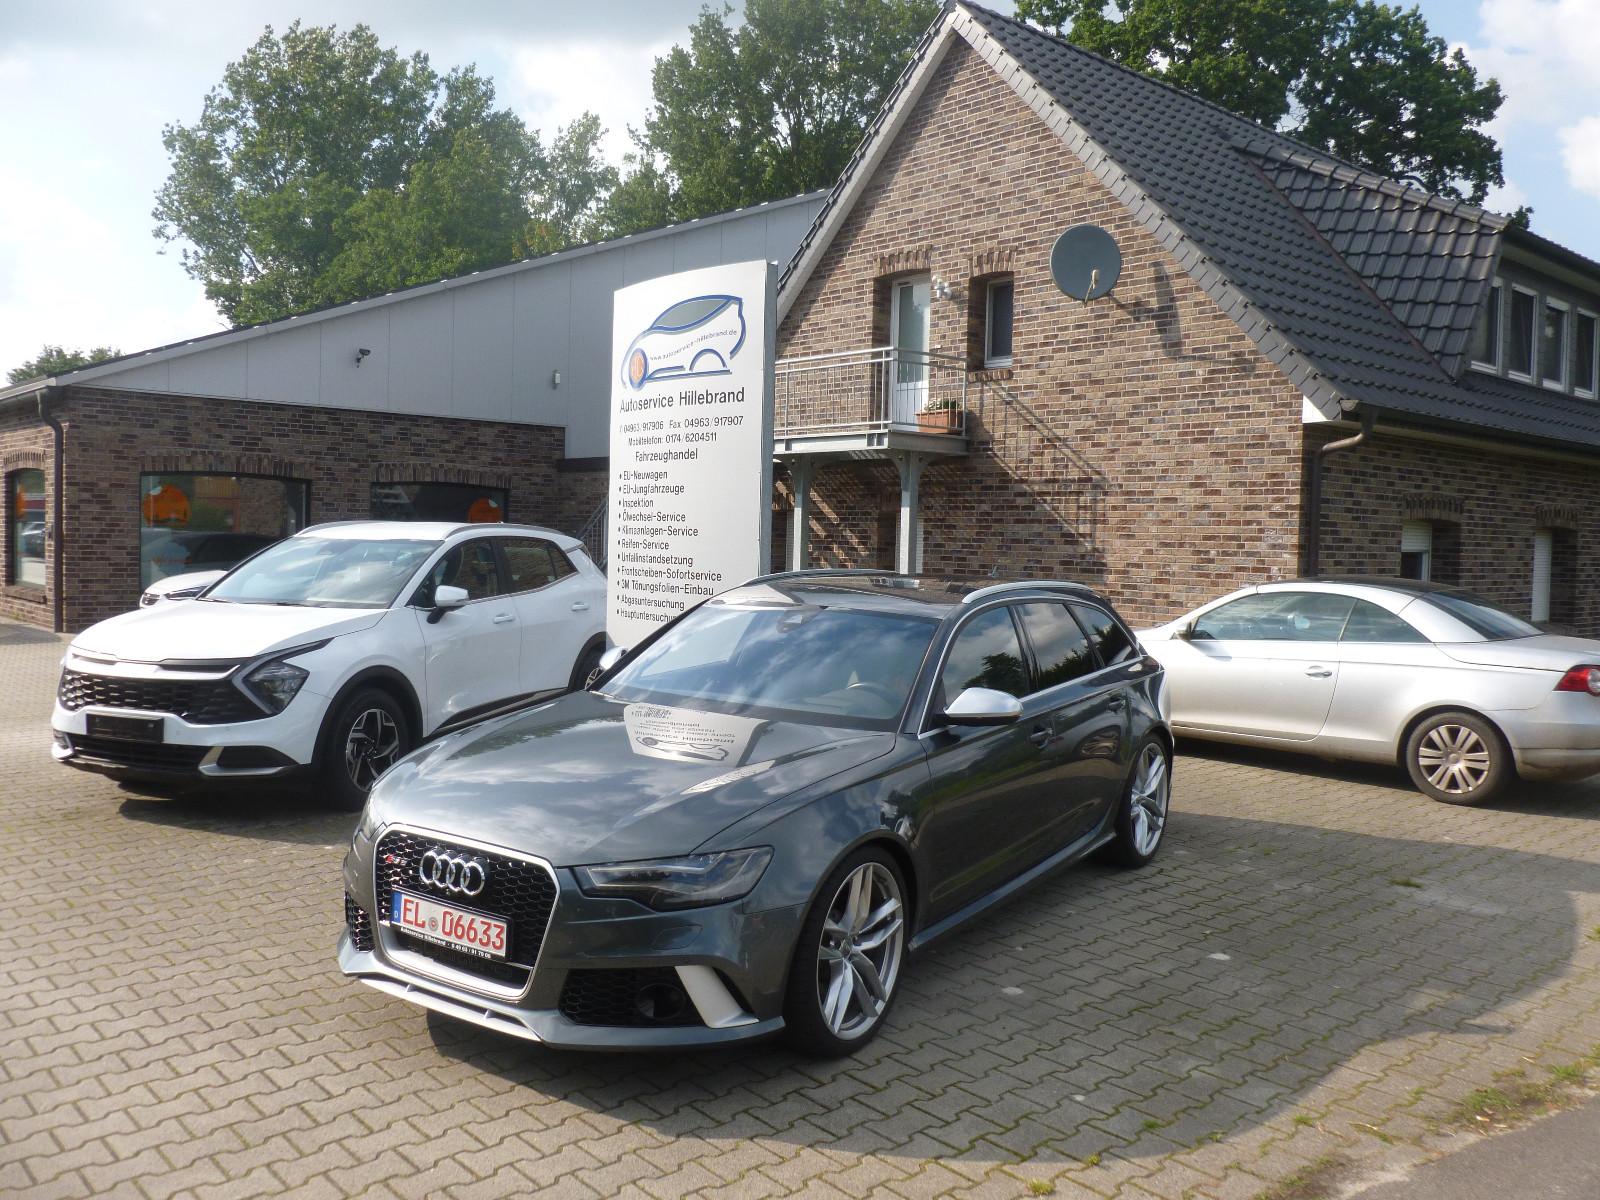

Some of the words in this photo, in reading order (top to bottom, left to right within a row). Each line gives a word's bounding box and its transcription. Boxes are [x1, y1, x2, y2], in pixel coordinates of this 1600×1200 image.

[619, 394, 674, 413] Autoservice
[679, 387, 745, 406] Hillebrand
[669, 420, 681, 429] Fax
[635, 448, 698, 463] Fahrzeughandel
[623, 470, 668, 481] EU-Neuwagen
[623, 483, 685, 495] EU-Jungfahrzeuge
[622, 498, 654, 508] Inspektion
[622, 509, 686, 522] Ölwechsel-Service
[622, 525, 699, 537] Klimaanlagen-Service
[621, 538, 670, 550] Reifen-Service
[621, 553, 693, 567] Unfallinstandsetzung
[621, 566, 722, 581] Frontscheiben-Sofortservice
[632, 580, 714, 596] Tönungsfolien-Einbau
[621, 595, 685, 611] Abgasuntersuchung
[402, 898, 426, 929] EL
[441, 910, 505, 950] 06633
